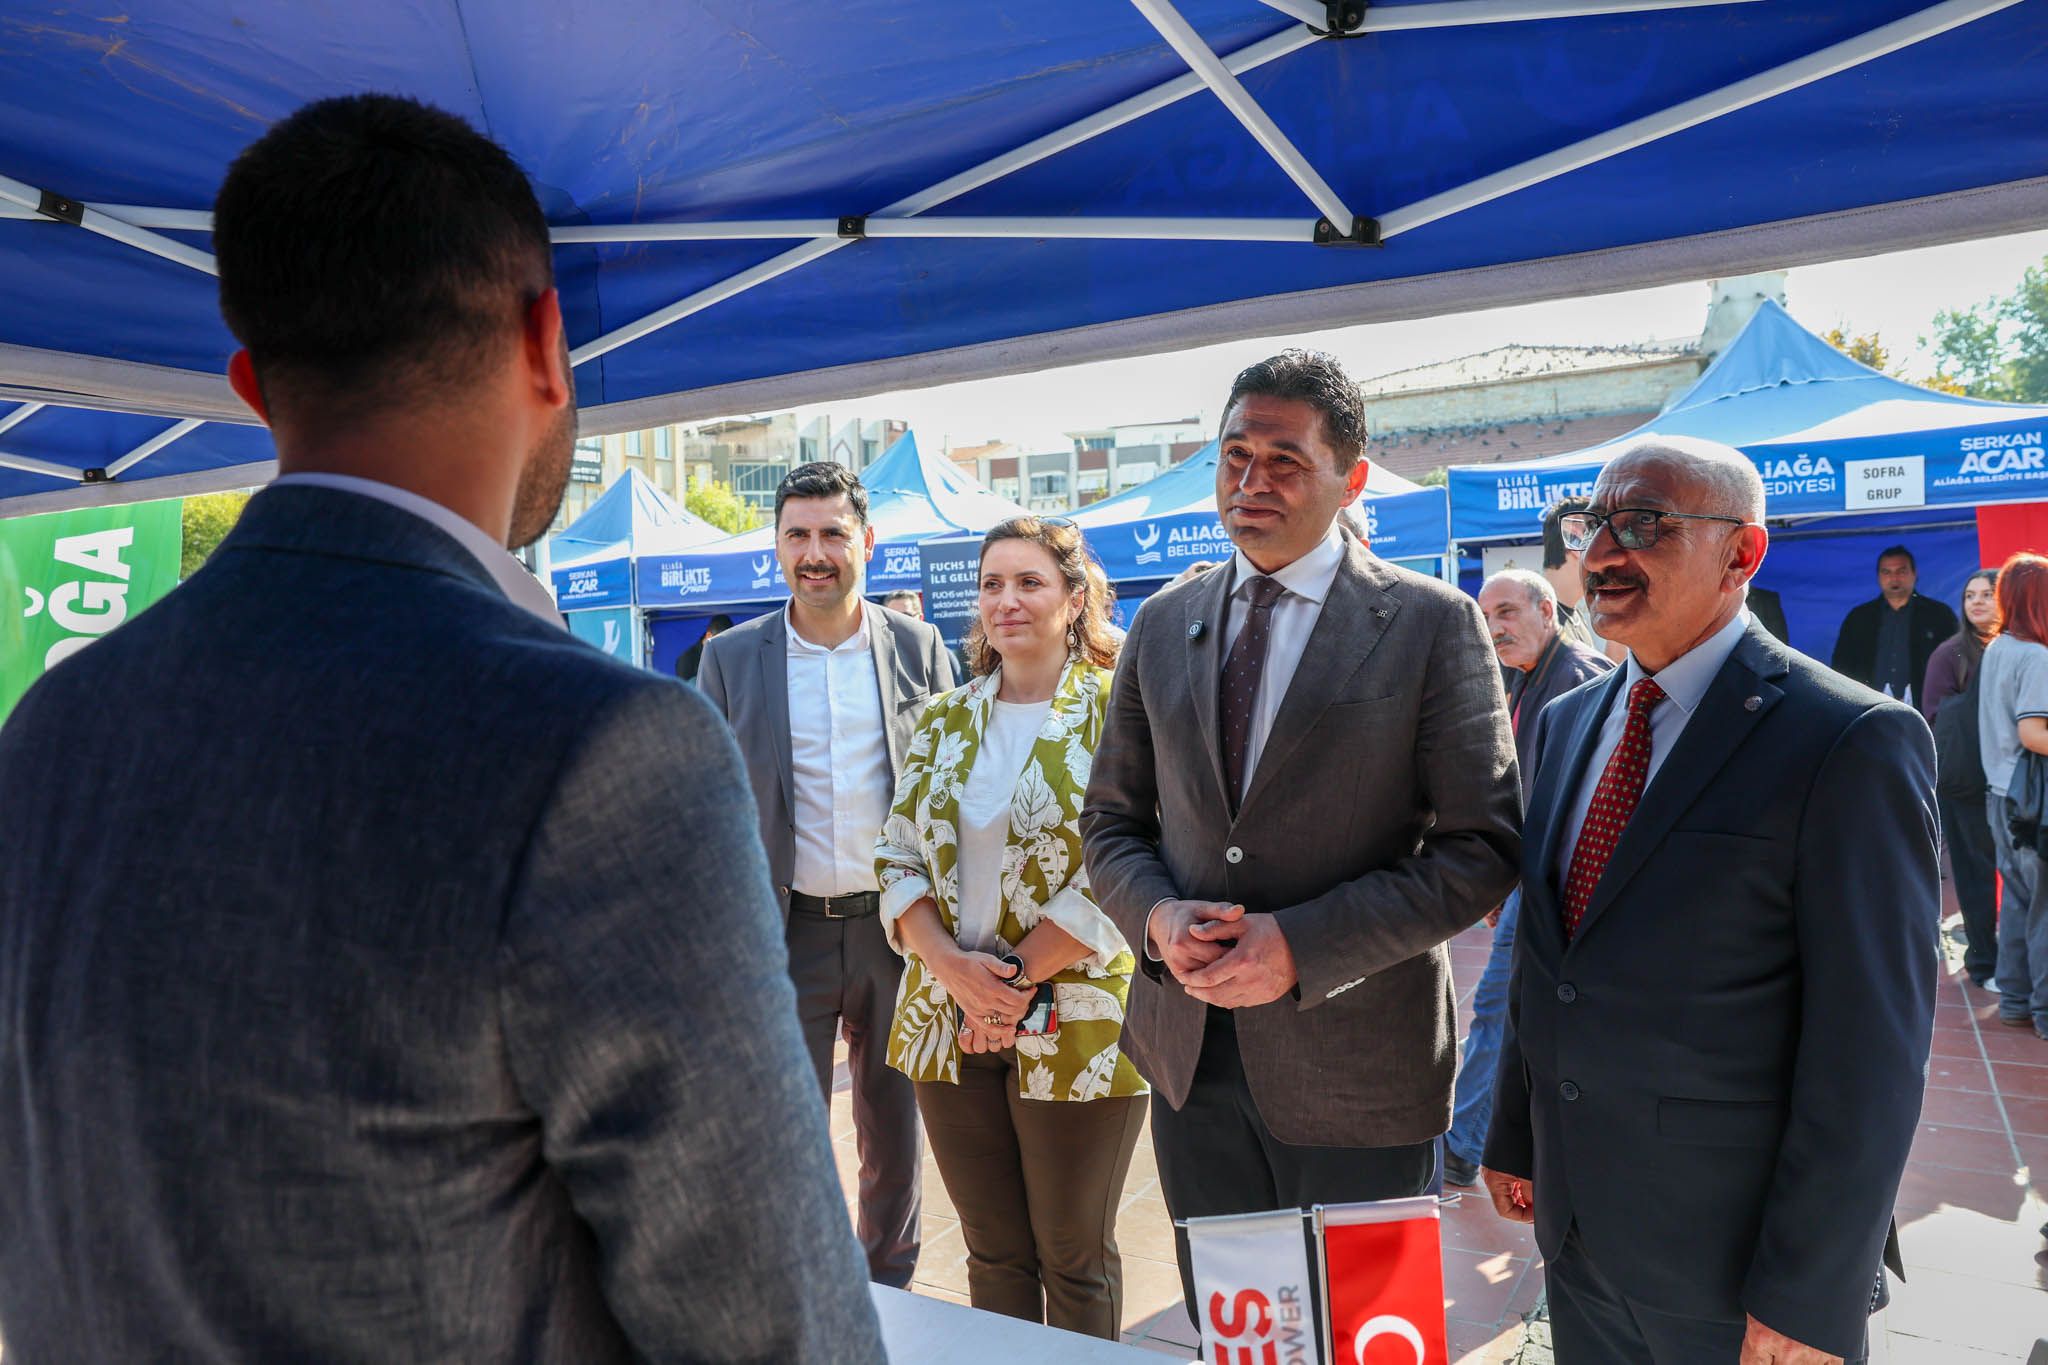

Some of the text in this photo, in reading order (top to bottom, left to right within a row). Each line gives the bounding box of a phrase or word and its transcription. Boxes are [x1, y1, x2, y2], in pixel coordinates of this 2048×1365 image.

[1960, 432, 2042, 451] SERKAN
[1759, 453, 1835, 479] İAĞA
[1958, 447, 2046, 474] ACAR
[1863, 466, 1906, 479] SOFRA
[1764, 478, 1836, 496] EDİYESİ
[1867, 487, 1902, 501] GRUP
[1167, 520, 1231, 544] ALİAĞ
[1167, 541, 1237, 557] BELEDİYES
[884, 556, 921, 574] ACAR
[929, 563, 965, 573] FUCHS
[568, 578, 599, 594] ACAR
